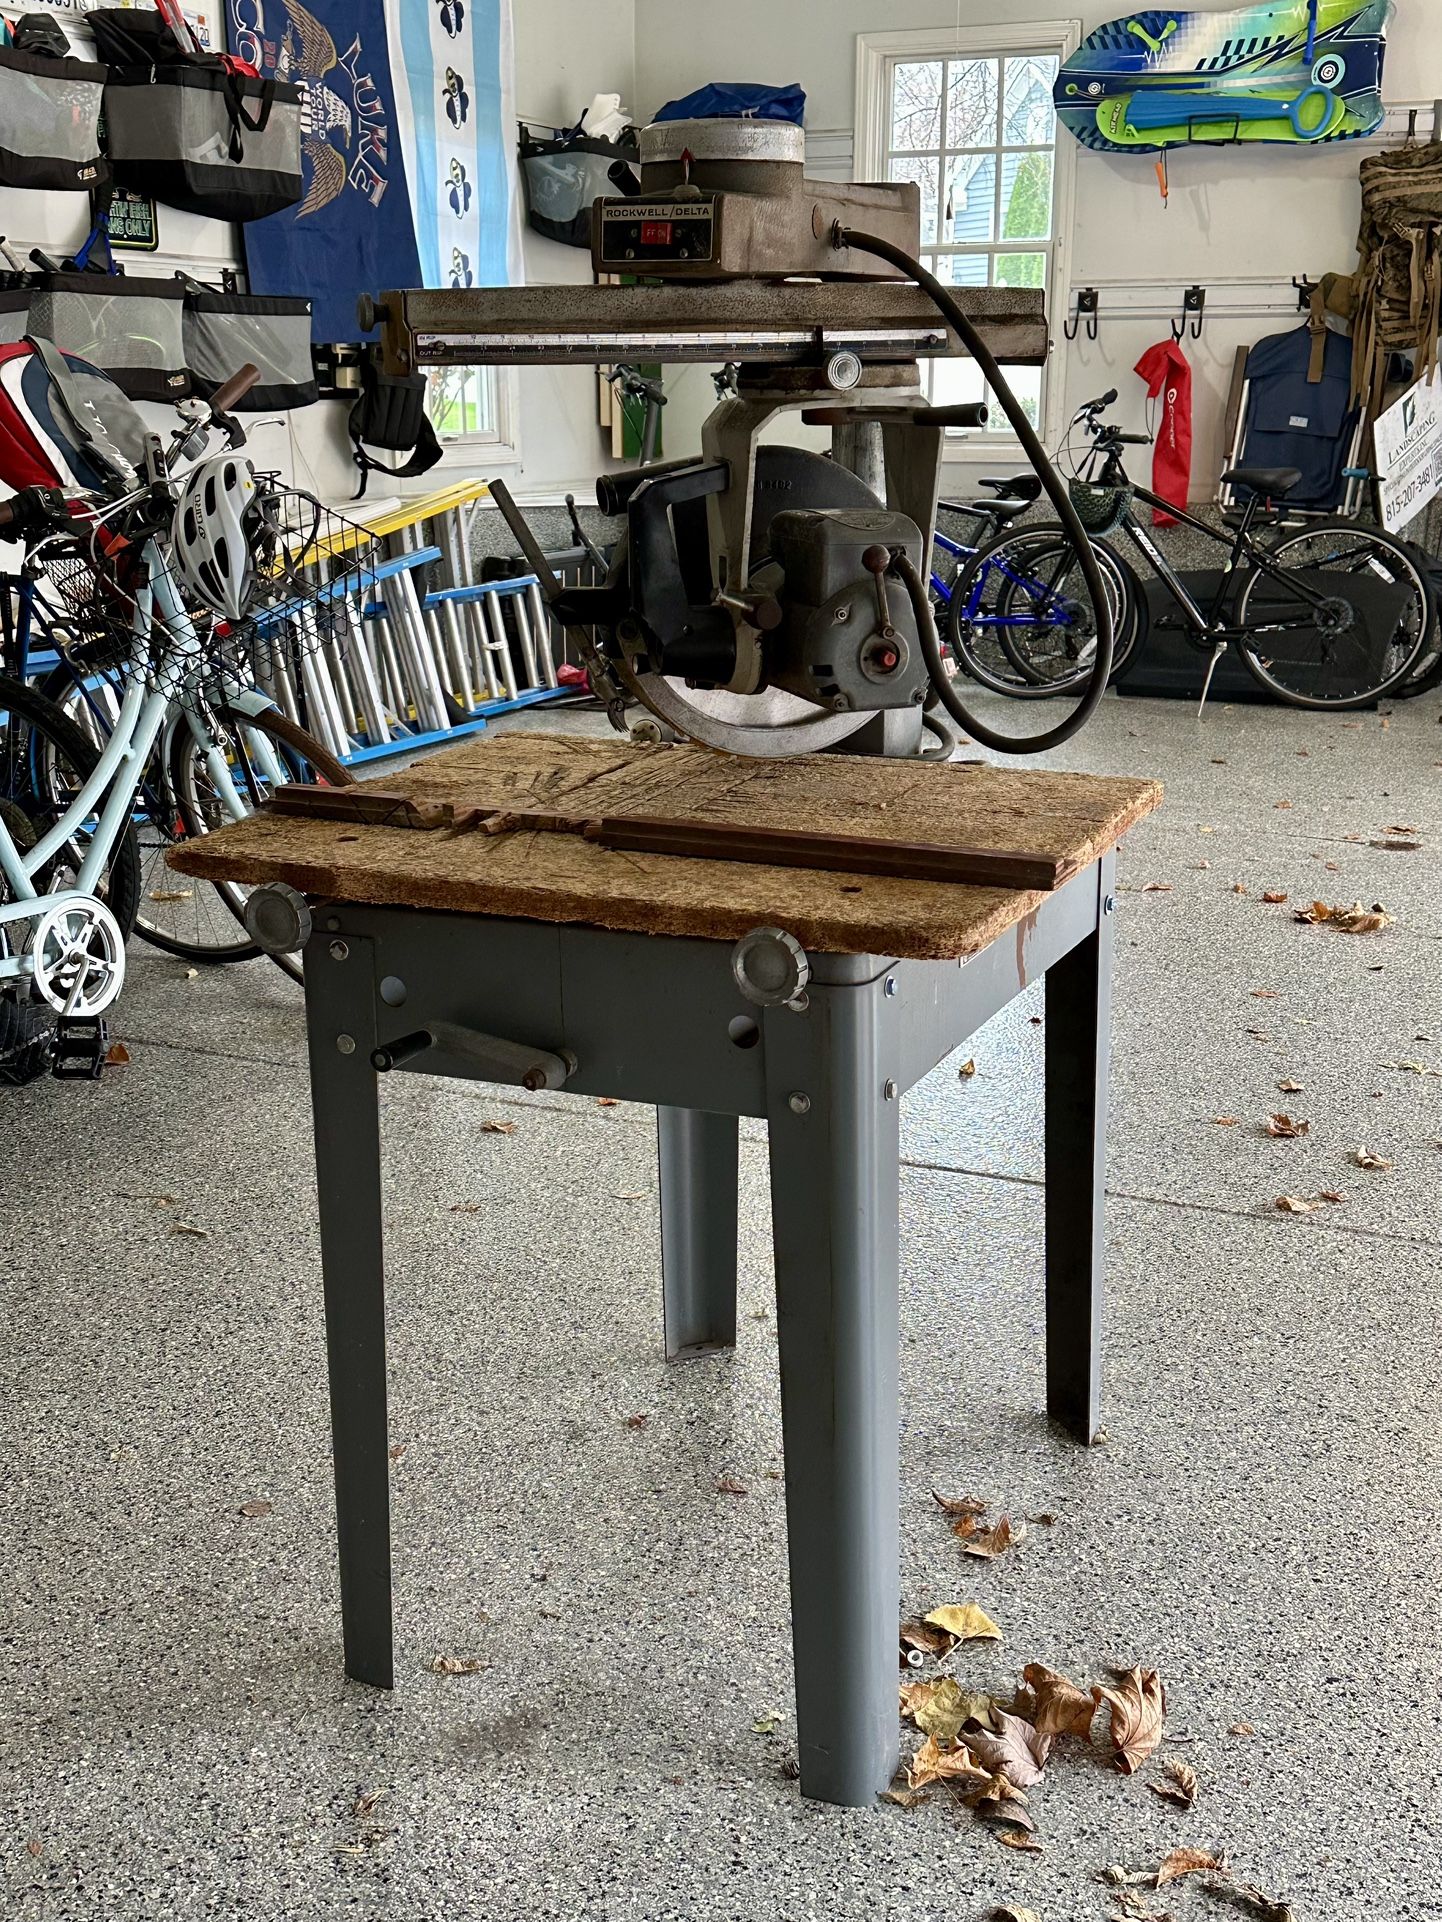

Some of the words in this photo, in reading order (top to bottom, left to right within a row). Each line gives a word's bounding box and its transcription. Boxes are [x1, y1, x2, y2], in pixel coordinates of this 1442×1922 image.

[310, 88, 320, 131] TOUR
[315, 82, 326, 140] WORLD
[338, 32, 388, 207] LUKE
[125, 218, 151, 236] ONLY
[606, 205, 709, 218] ROCKWELL/DELTA
[1388, 411, 1436, 464] LANDSCAPING
[194, 493, 204, 527] GIRO
[1385, 464, 1433, 521] 815-207-3481
[1132, 527, 1158, 555] REID
